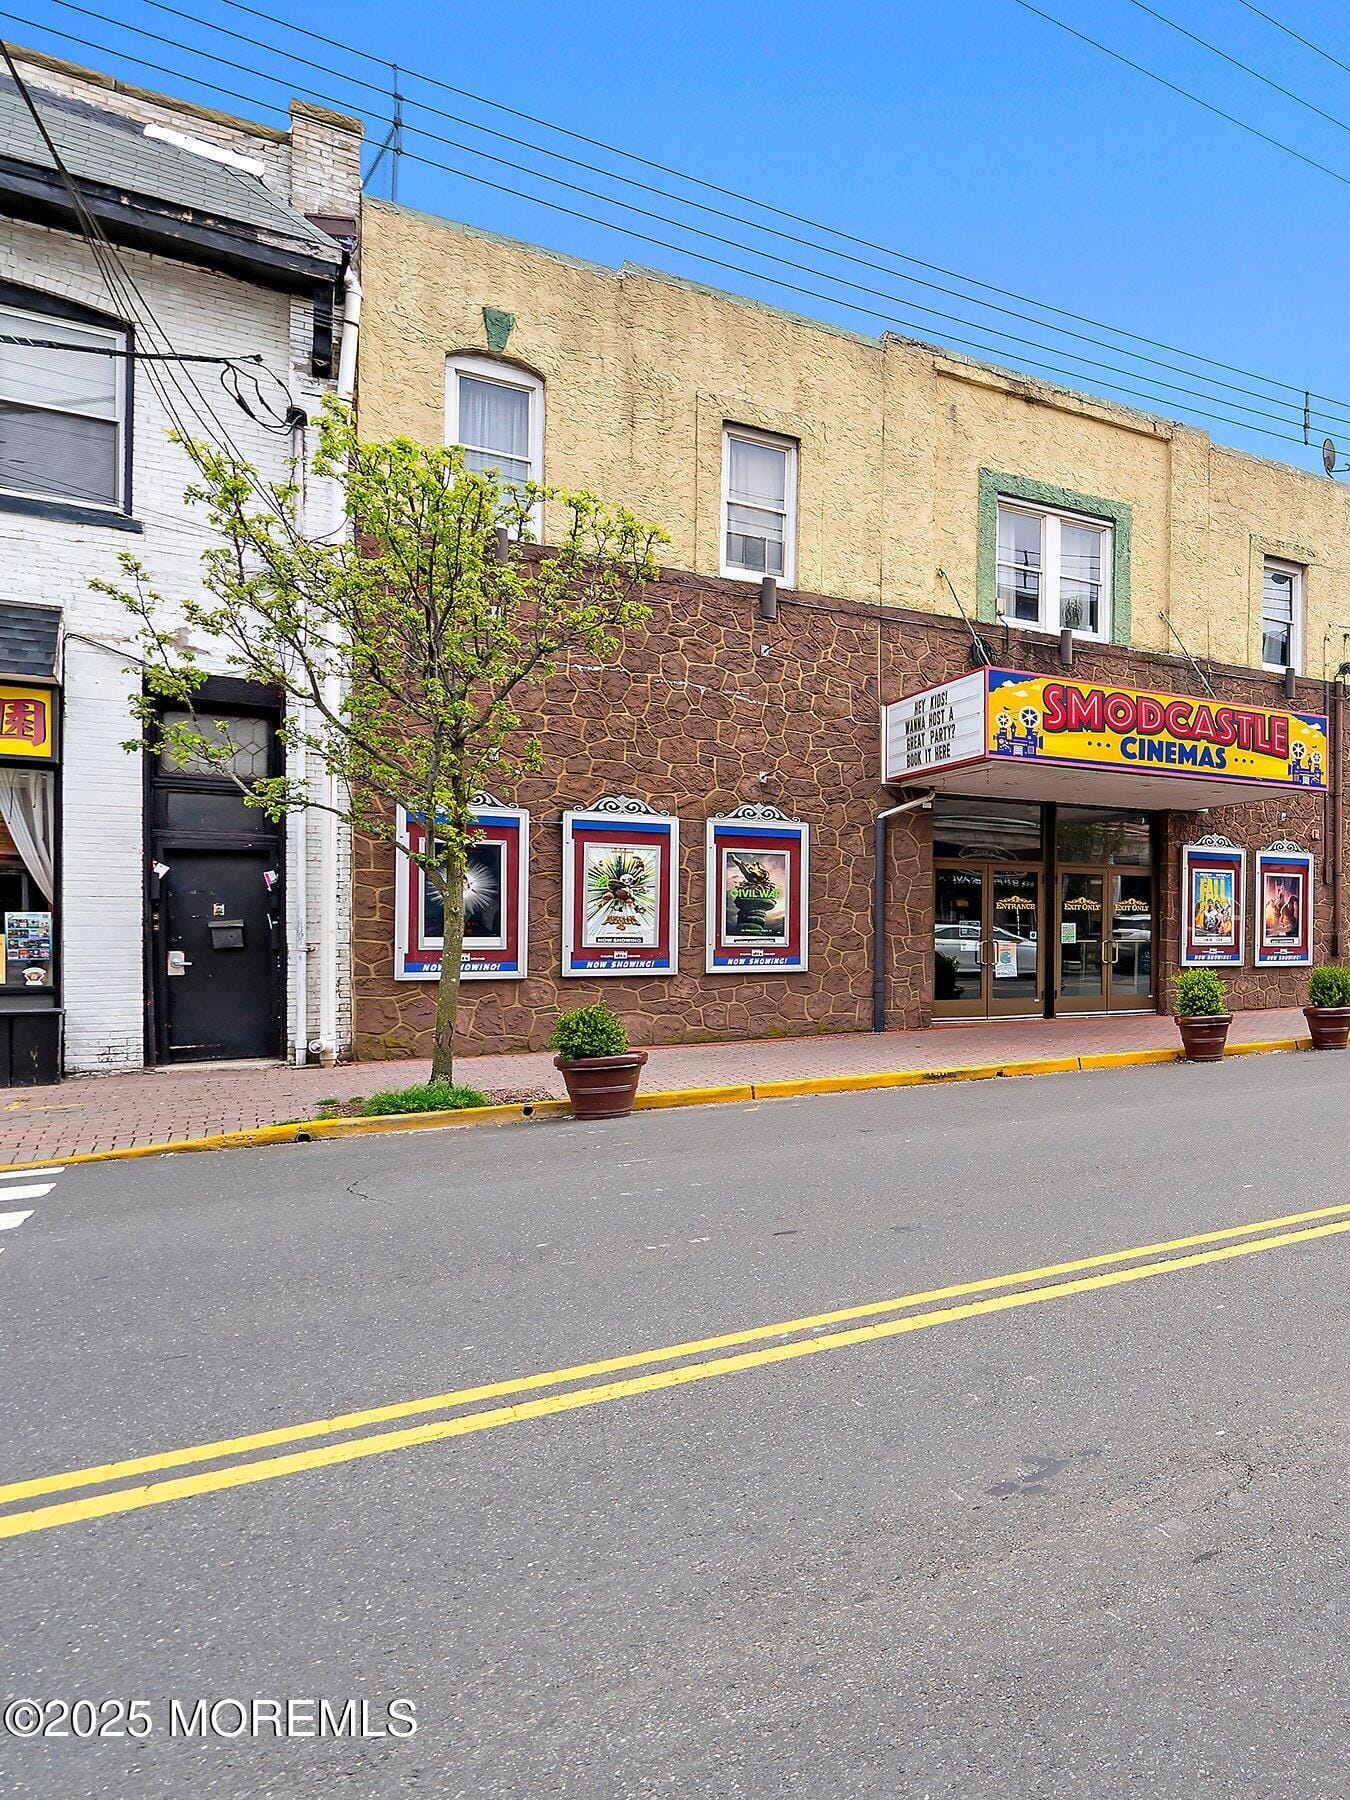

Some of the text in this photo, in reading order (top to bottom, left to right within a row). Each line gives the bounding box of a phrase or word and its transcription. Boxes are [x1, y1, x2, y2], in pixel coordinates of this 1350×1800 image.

[914, 690, 948, 717] HEY KIDS!
[905, 706, 954, 736] WANNA HOST A
[1043, 683, 1290, 760] SMODCASTLE
[906, 723, 956, 752] GREAT PARTY?
[906, 743, 951, 769] BOOK IT HERE
[1119, 736, 1226, 769] CINEMAS
[729, 888, 782, 898] CIVIL WAR
[995, 902, 1036, 910] ENTRANCE
[1063, 903, 1101, 911] EXIT ONLY
[1114, 904, 1150, 912] EXIT ONLY
[586, 960, 655, 969] NOW SHOWING!
[748, 957, 788, 965] SHOWING!
